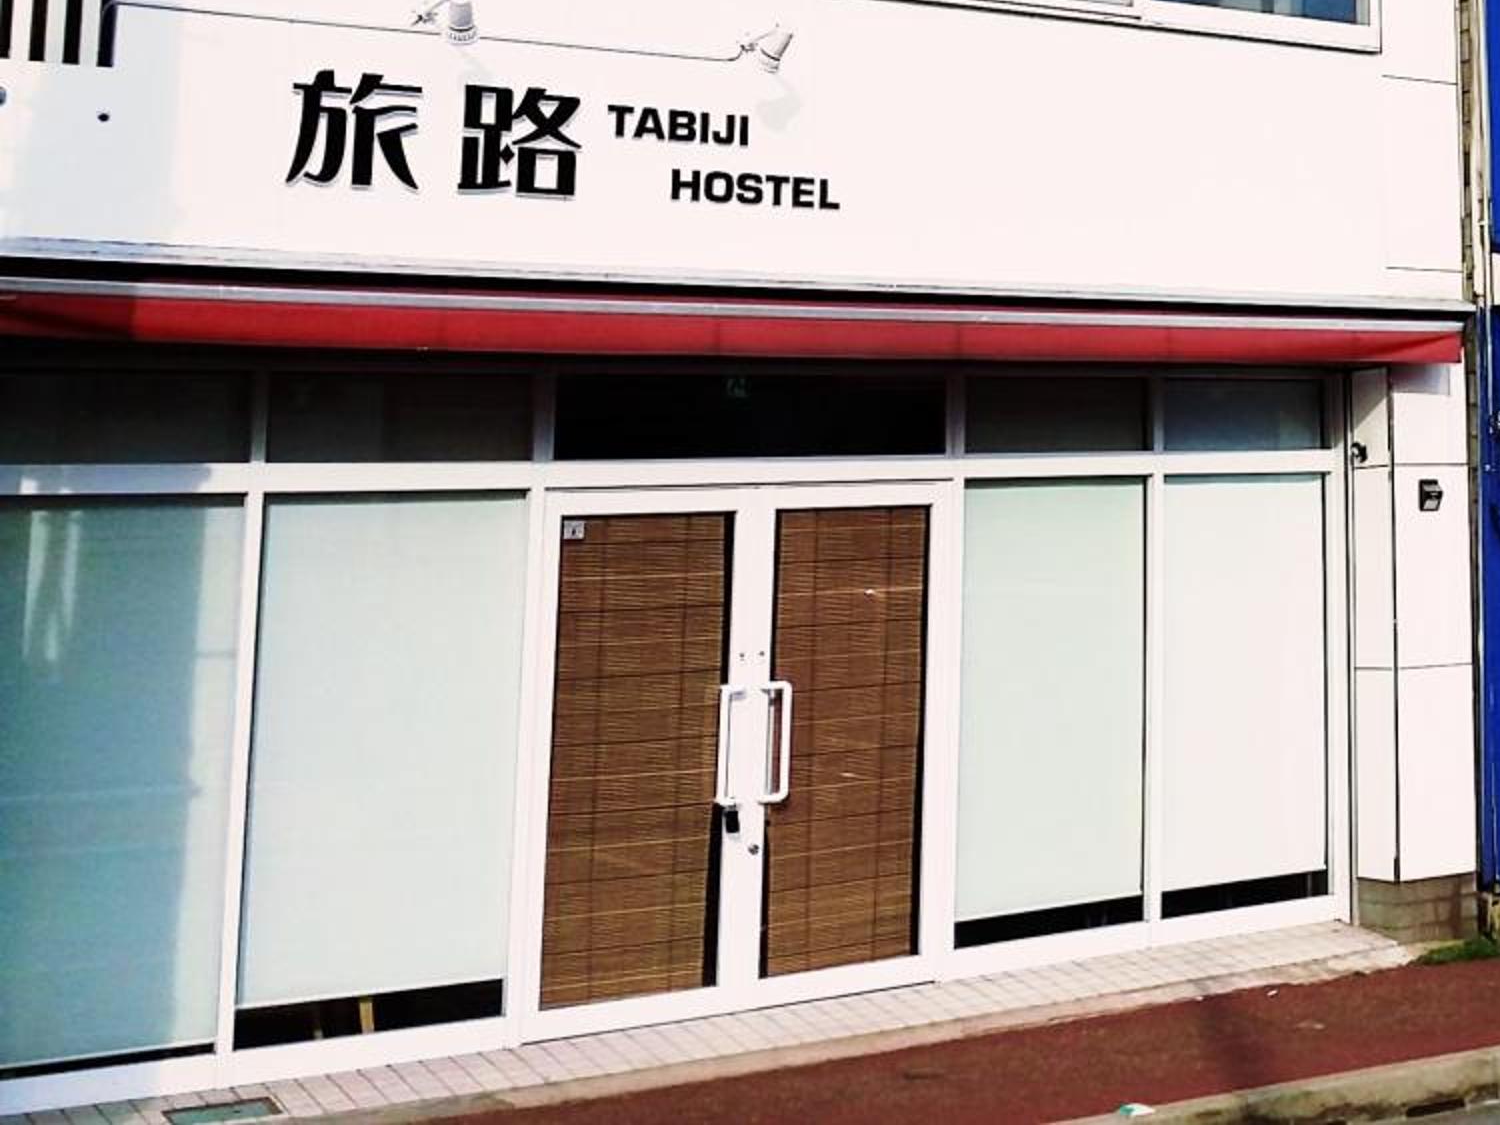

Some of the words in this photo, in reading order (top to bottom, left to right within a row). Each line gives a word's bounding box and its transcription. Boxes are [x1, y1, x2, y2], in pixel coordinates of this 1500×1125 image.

[285, 69, 582, 201] 旅路
[607, 103, 750, 146] TABIJI
[670, 168, 841, 210] HOSTEL
